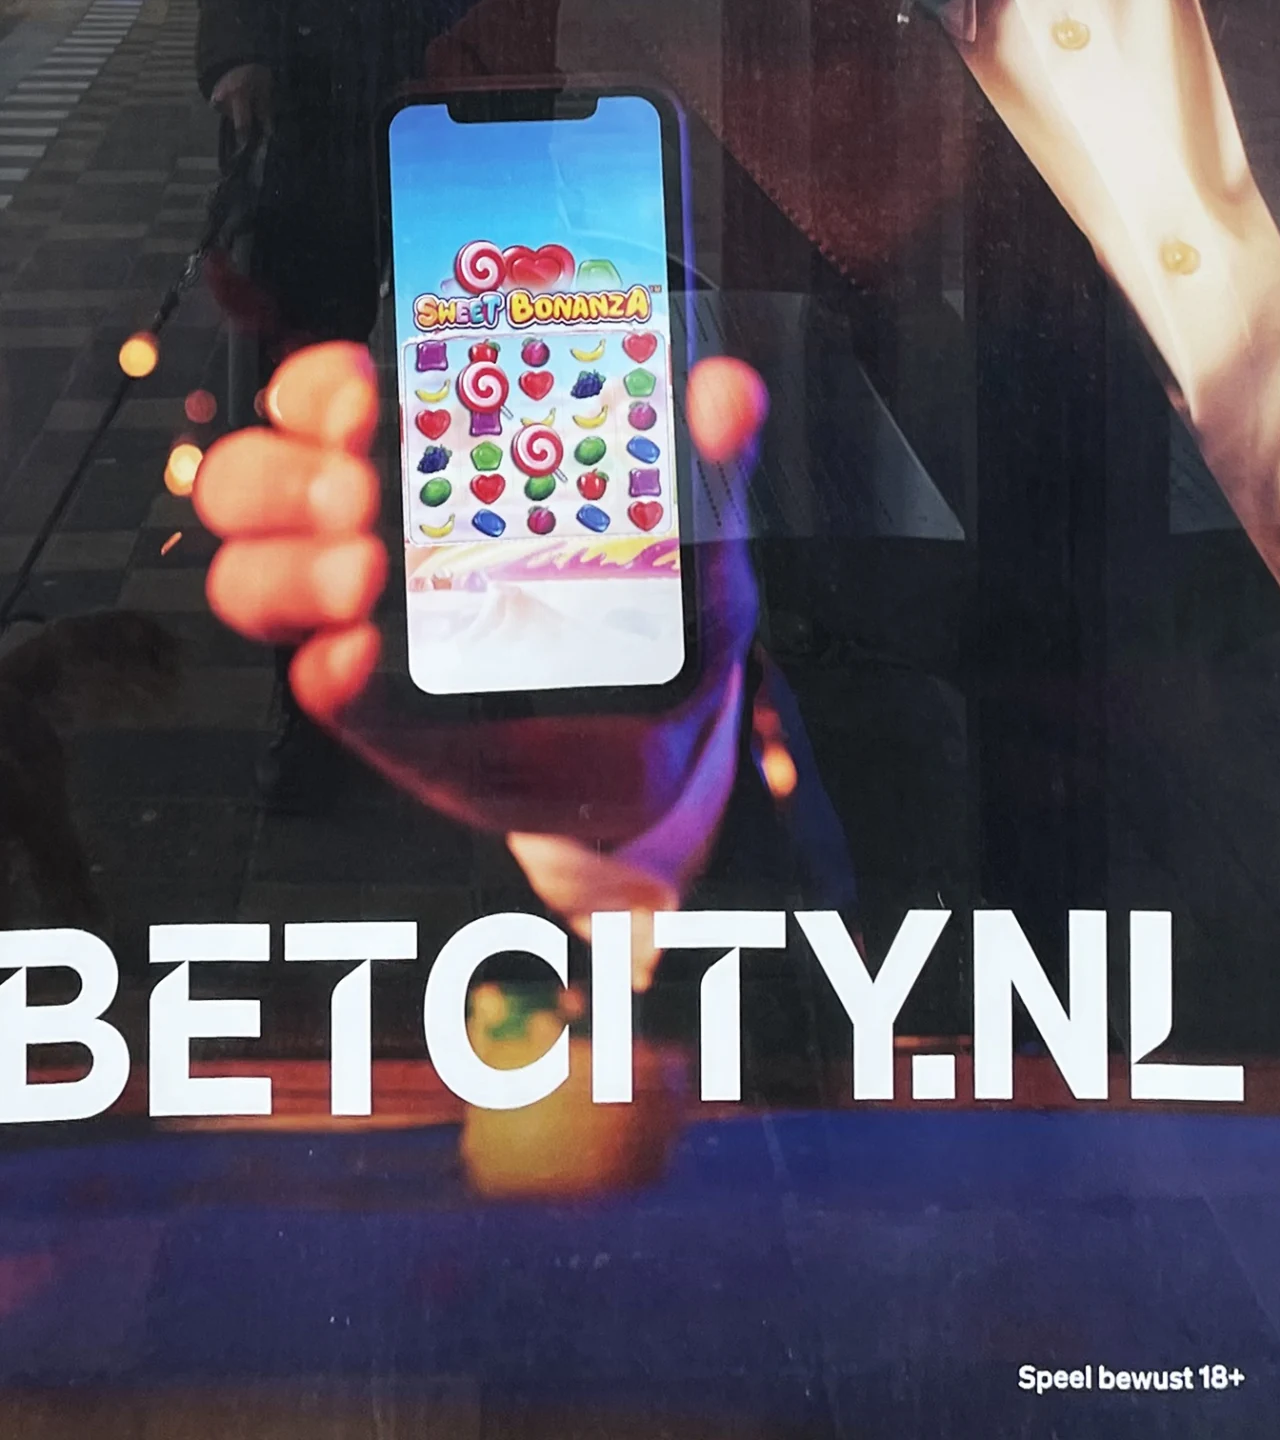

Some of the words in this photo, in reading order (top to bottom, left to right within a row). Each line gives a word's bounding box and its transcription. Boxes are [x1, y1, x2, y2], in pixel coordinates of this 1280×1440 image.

[414, 292, 504, 329] SWEET
[508, 286, 652, 328] BONANZA
[1018, 1365, 1092, 1394] Speel
[1098, 1365, 1193, 1390] bewust
[1199, 1365, 1246, 1389] 18+
